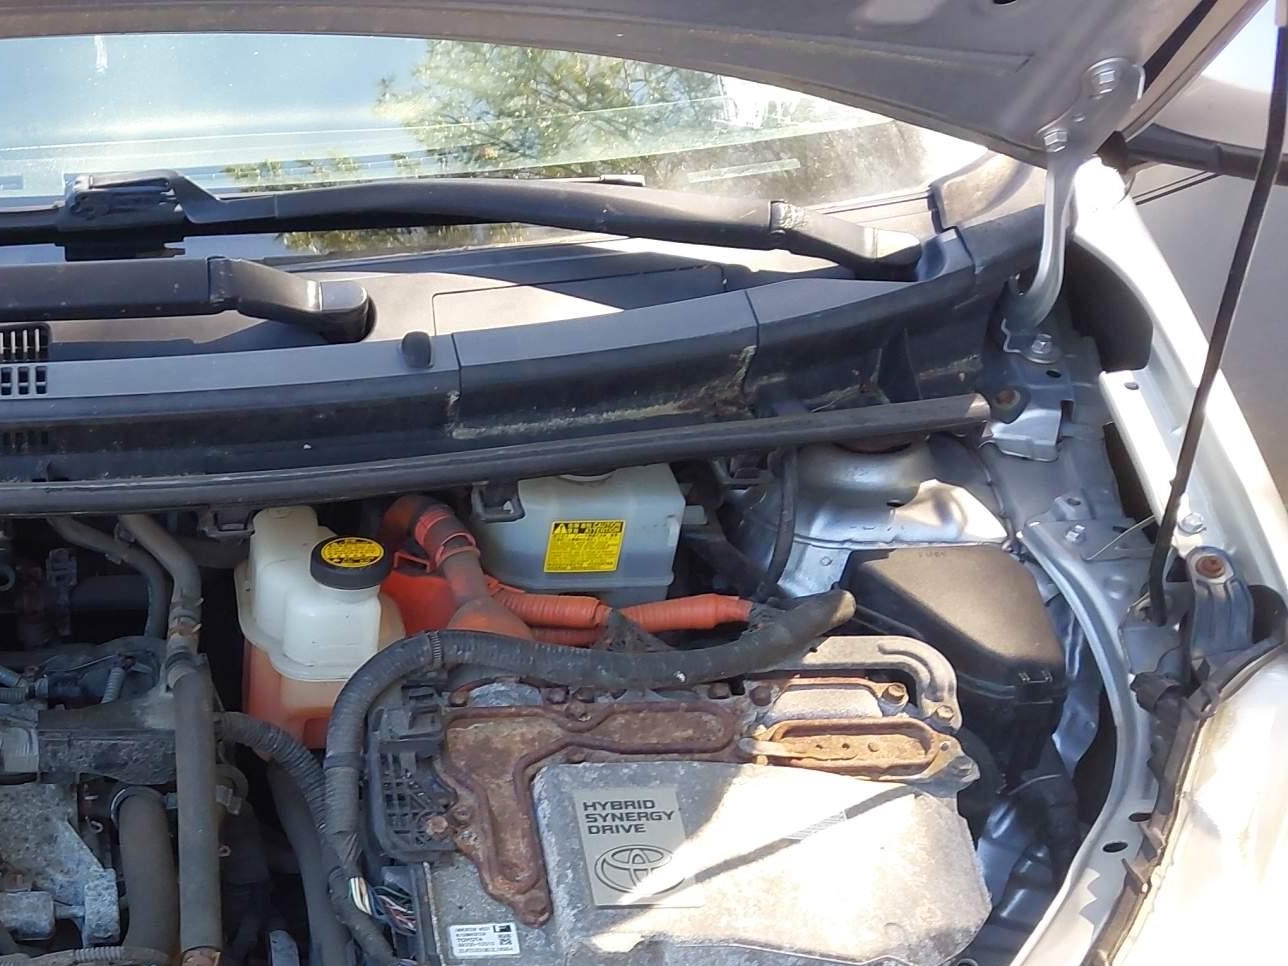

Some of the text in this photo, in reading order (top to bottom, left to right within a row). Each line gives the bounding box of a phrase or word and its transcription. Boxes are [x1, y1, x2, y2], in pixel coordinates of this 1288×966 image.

[582, 799, 656, 811] HYBRID
[585, 810, 675, 823] SYNERGY
[587, 823, 647, 835] DRIVE
